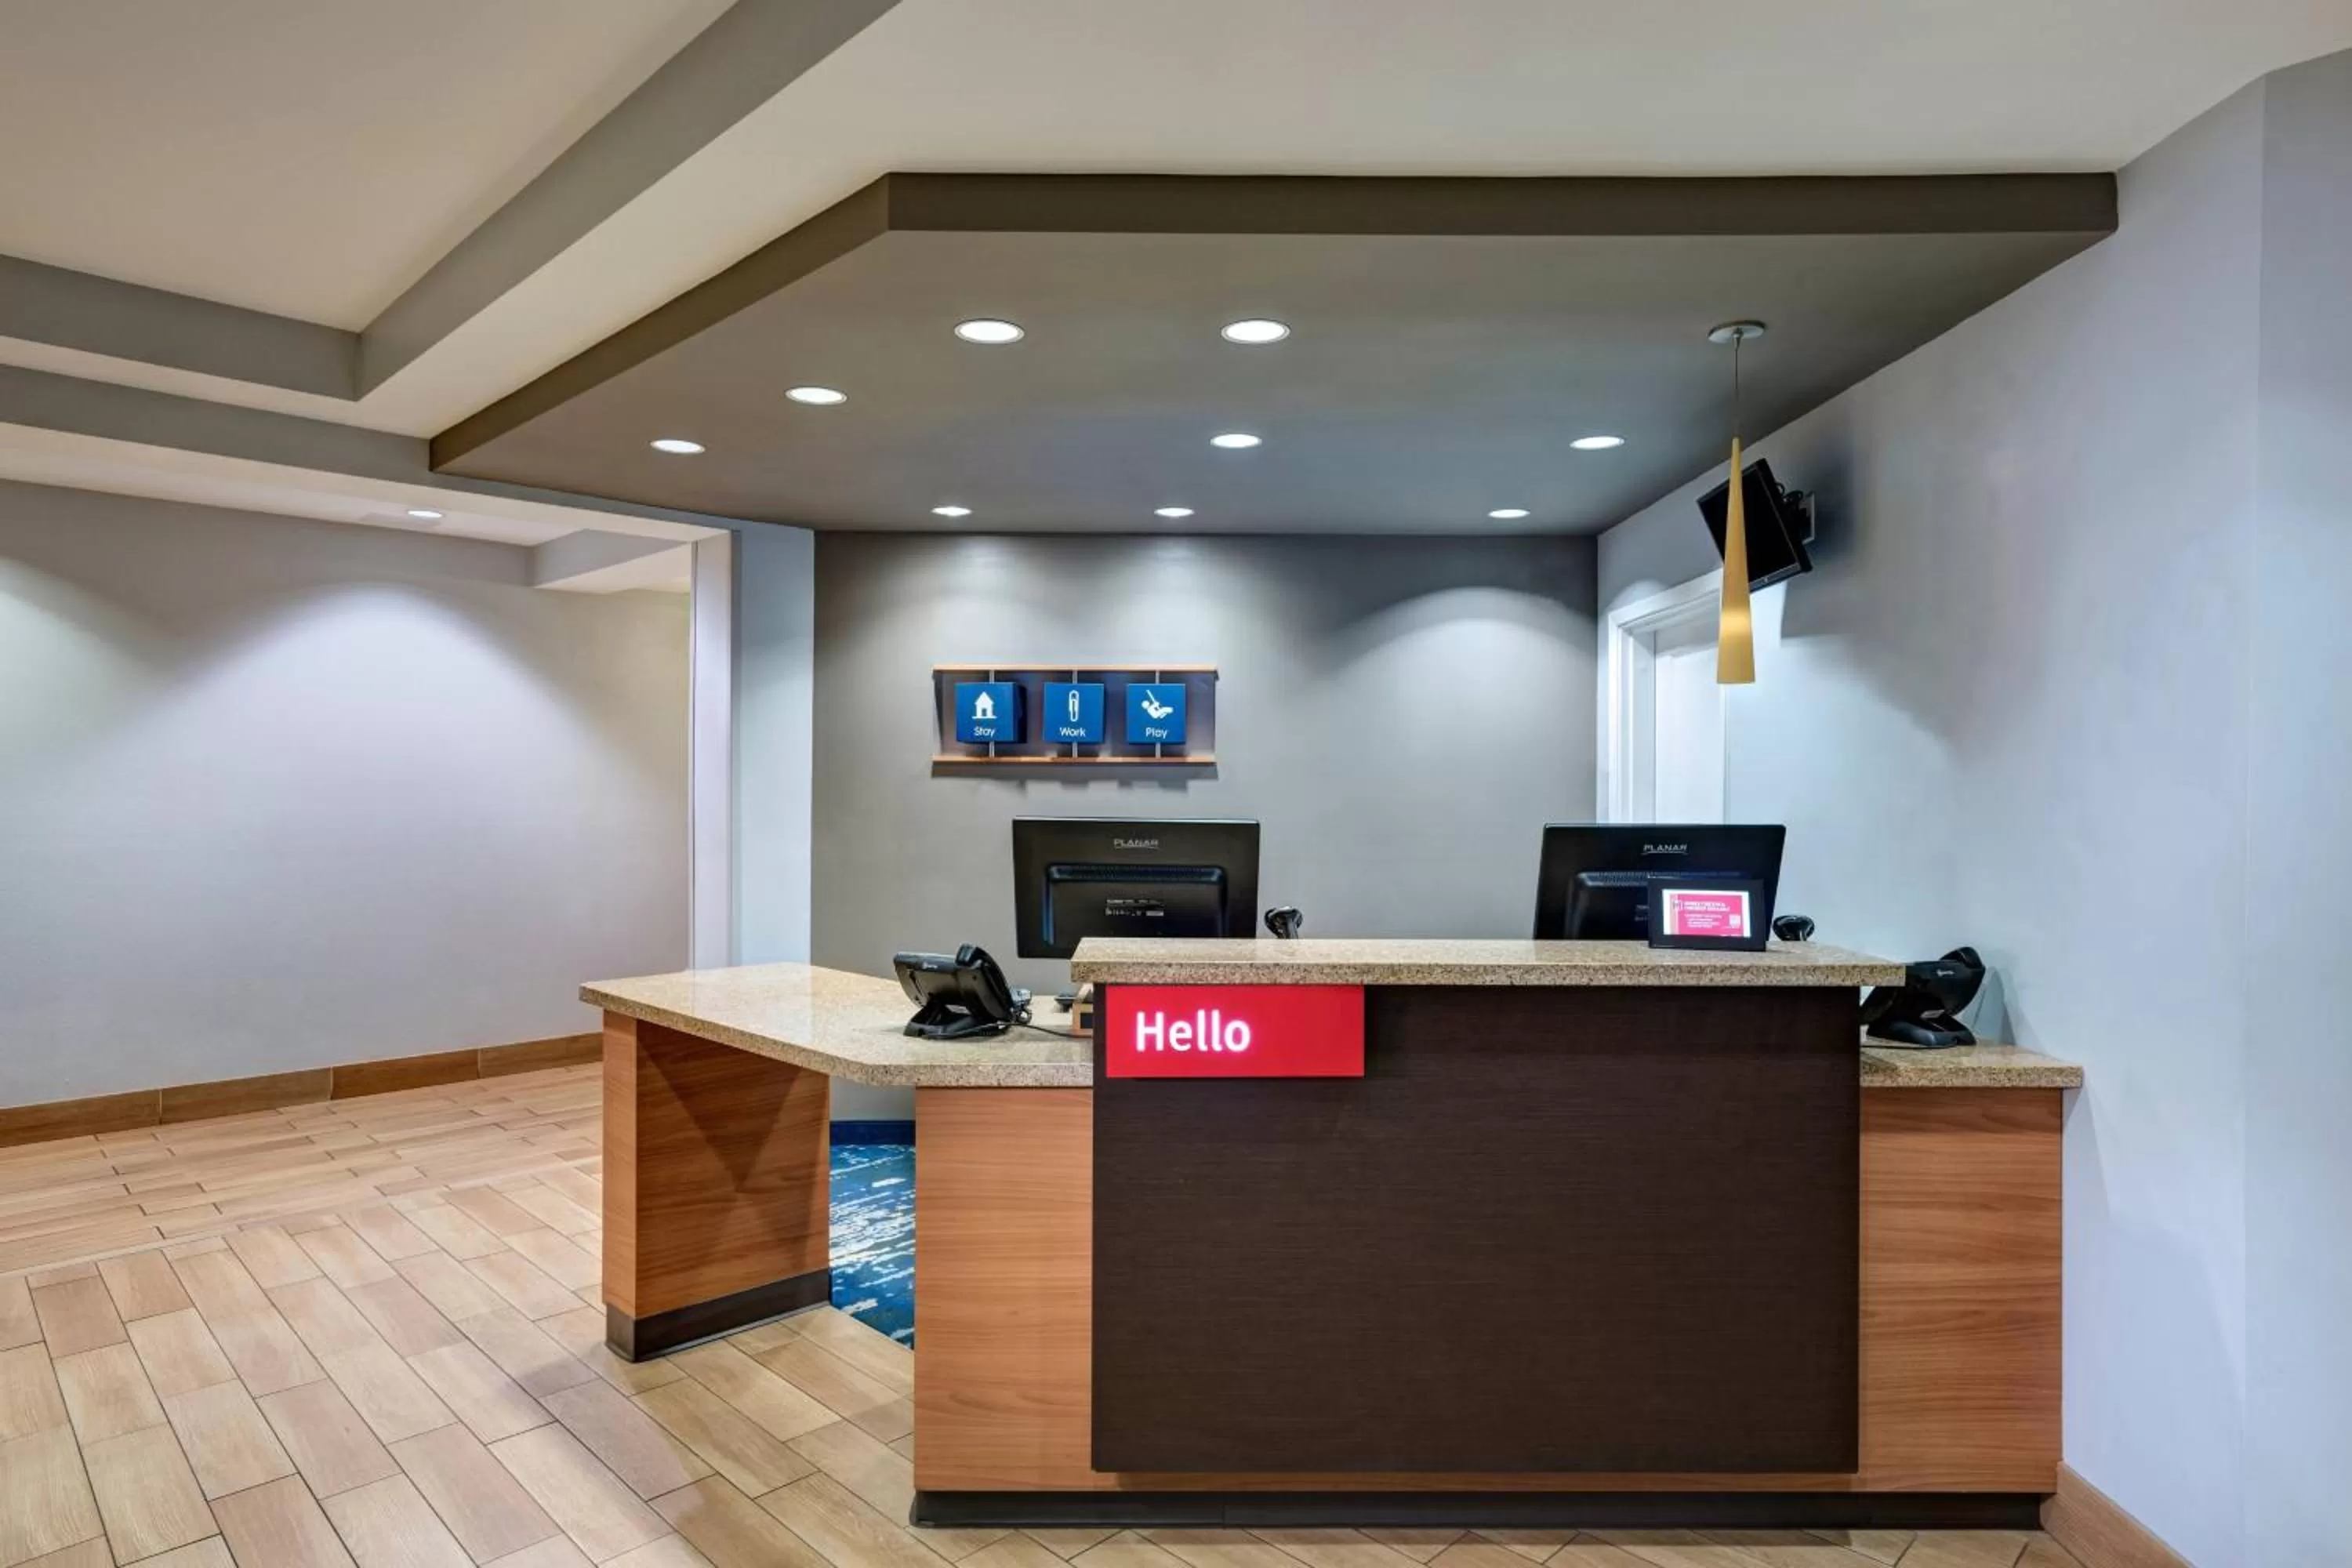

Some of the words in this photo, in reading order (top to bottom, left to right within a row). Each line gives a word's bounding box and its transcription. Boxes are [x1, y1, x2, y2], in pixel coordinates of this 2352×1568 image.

[973, 726, 996, 738] Stay
[1059, 726, 1087, 738] Work
[1145, 726, 1168, 739] Play
[1135, 1009, 1252, 1052] Hello
